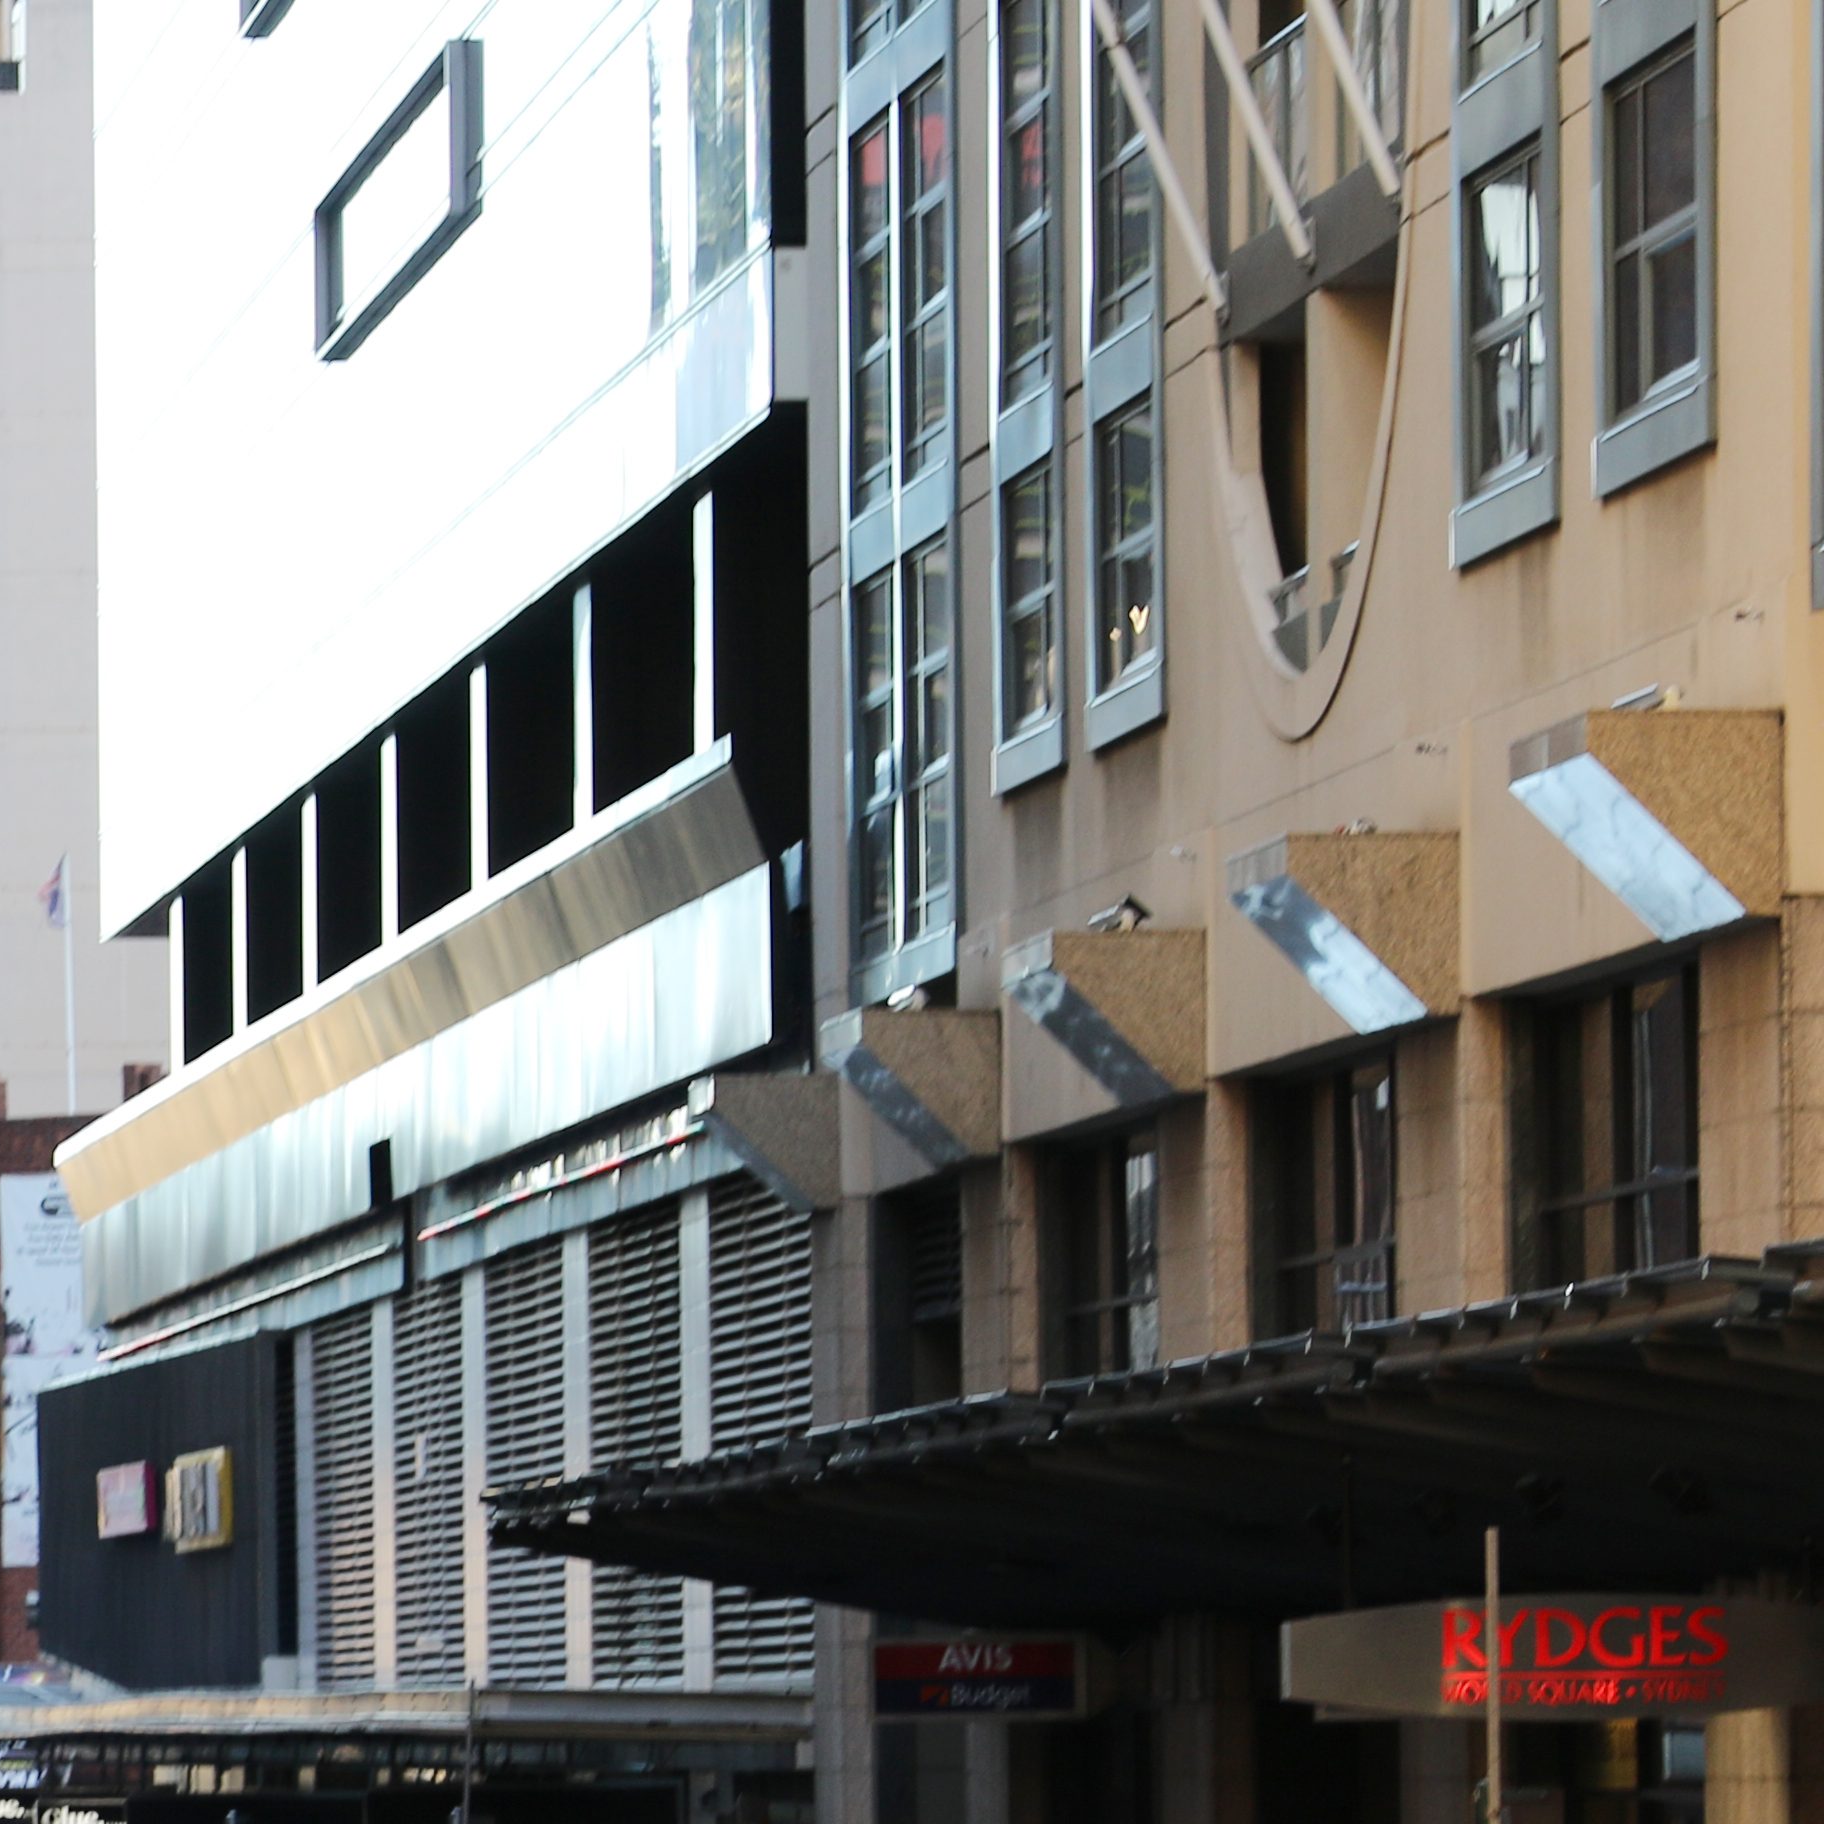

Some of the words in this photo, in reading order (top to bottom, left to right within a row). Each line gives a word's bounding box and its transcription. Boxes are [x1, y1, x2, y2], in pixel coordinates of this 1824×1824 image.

[1441, 1606, 1729, 1669] RYDGES
[938, 1642, 1014, 1673] AVIS
[951, 1680, 1030, 1711] Budget
[1527, 1678, 1622, 1707] SQUARE
[1640, 1675, 1726, 1705] SYDNEY
